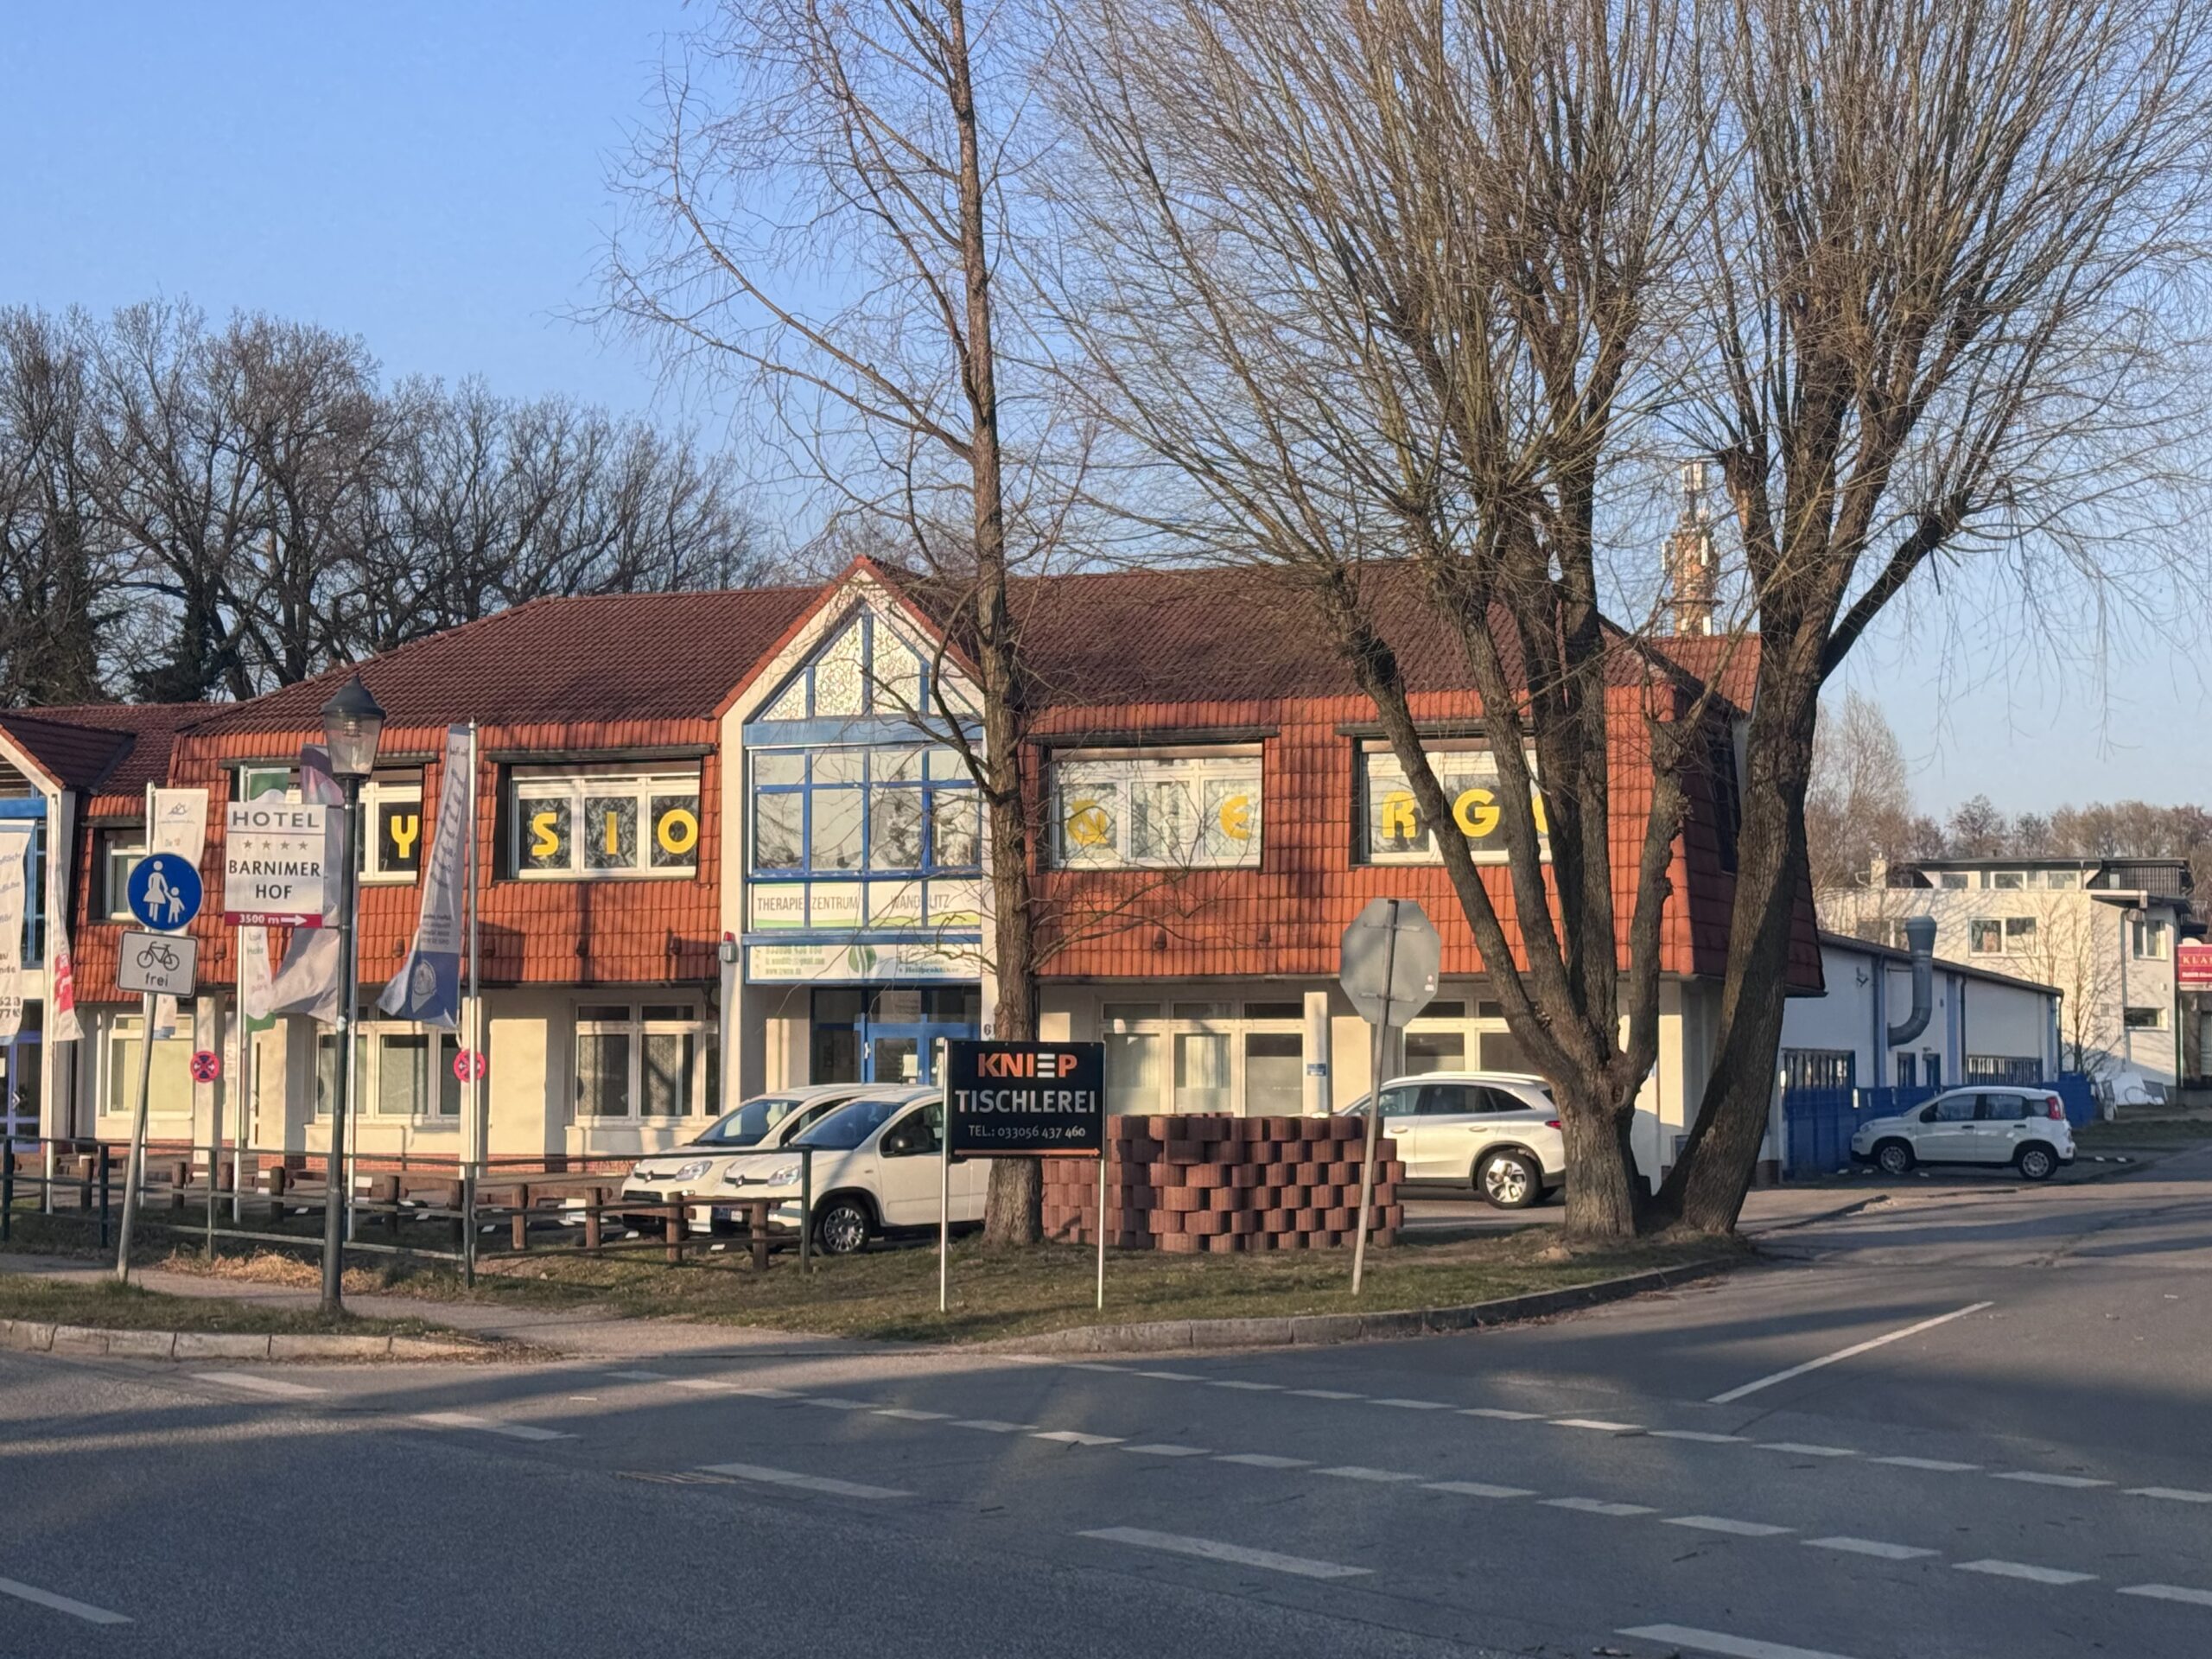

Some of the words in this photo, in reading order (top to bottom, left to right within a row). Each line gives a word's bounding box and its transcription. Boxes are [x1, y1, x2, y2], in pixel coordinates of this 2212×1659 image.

[232, 810, 320, 828] HOTEL
[228, 860, 321, 877] BARNIMER
[256, 884, 292, 899] HOF
[758, 897, 804, 912] THERAPIE
[811, 896, 858, 910] ZENTRUM
[238, 914, 264, 924] 3500
[268, 916, 279, 925] m
[145, 972, 168, 987] frei
[977, 1052, 1077, 1078] KNIEP
[955, 1090, 1096, 1114] TISCHLEREI
[969, 1125, 995, 1138] TEL.:
[997, 1125, 1039, 1140] 033056
[1041, 1127, 1061, 1140] 437
[1065, 1125, 1086, 1138] 460
